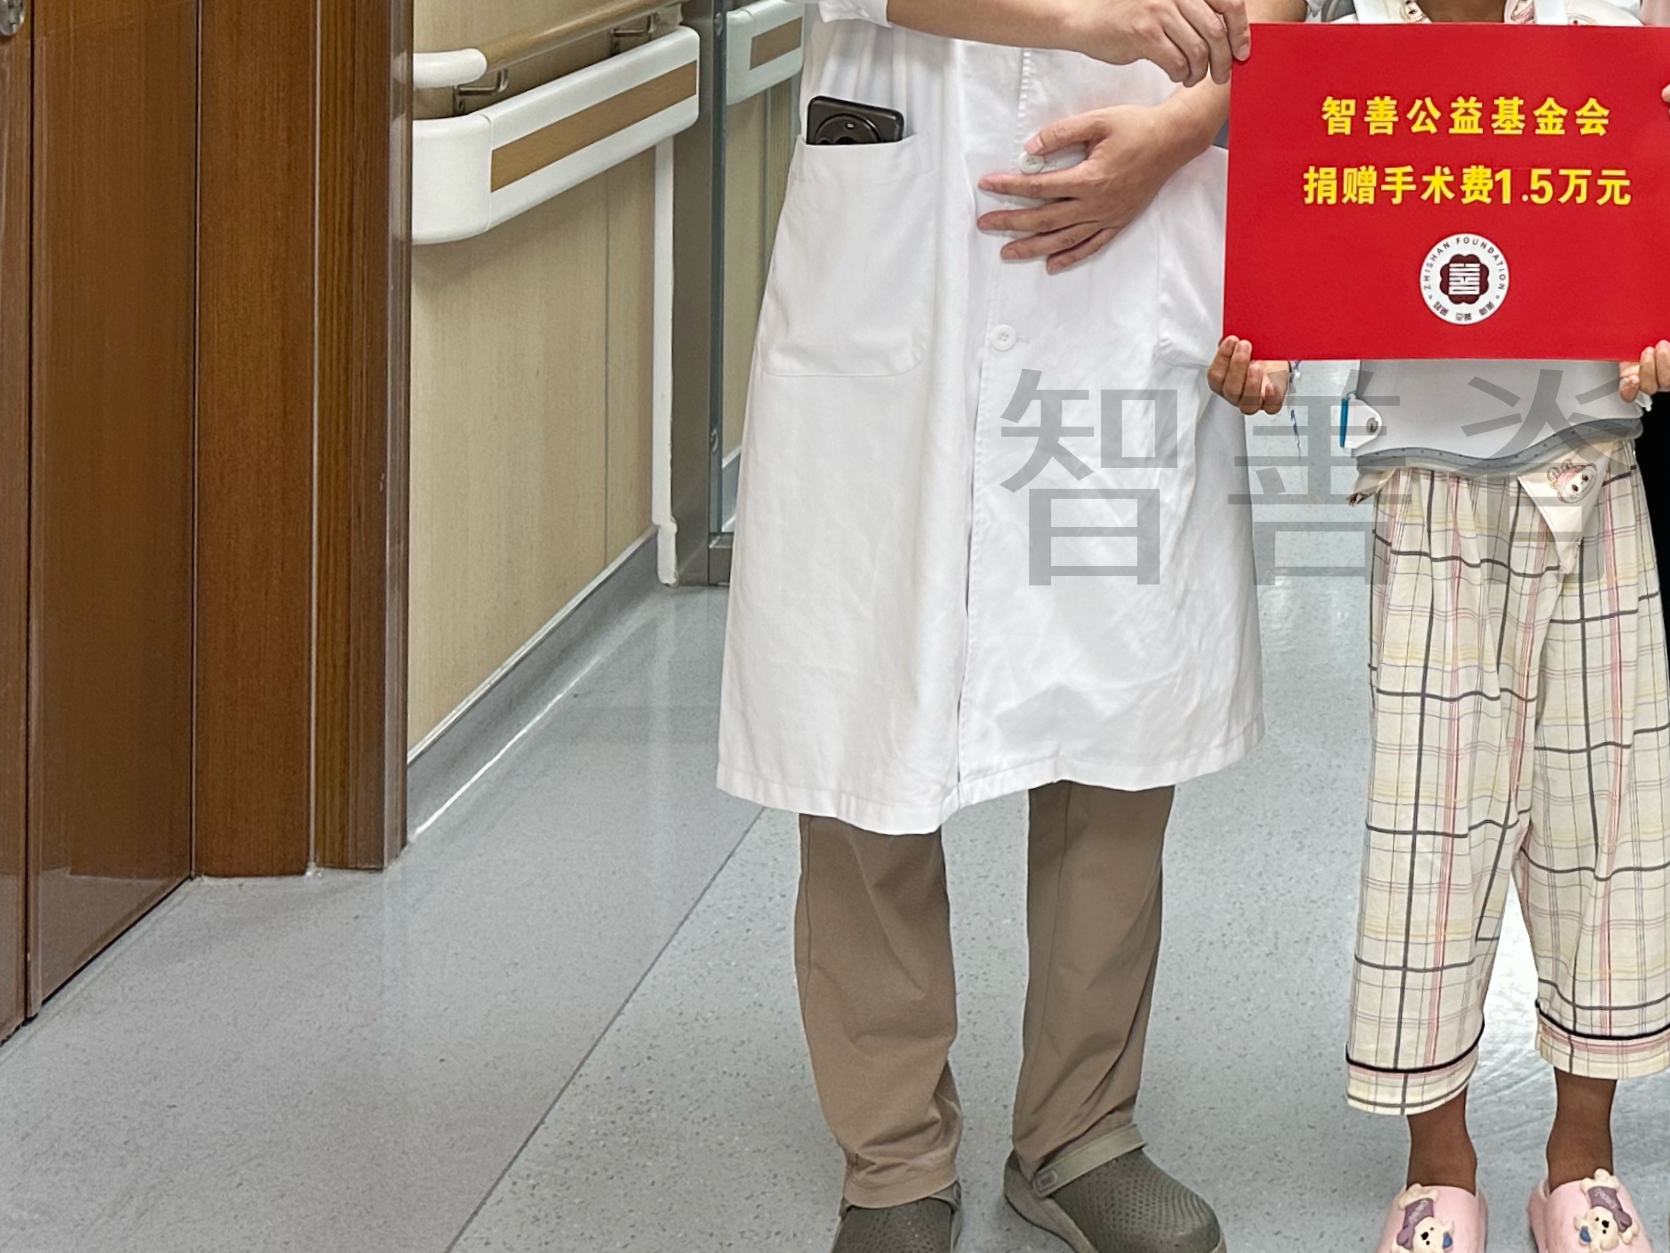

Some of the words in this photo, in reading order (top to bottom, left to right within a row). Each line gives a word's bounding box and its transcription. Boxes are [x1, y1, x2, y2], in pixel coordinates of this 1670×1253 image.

[1321, 95, 1611, 137] 智善公益基金会
[1302, 164, 1632, 207] 捐赠手术费1.5万元
[1423, 241, 1451, 290] ZHISHAN
[1455, 236, 1507, 291] FOUNDATION
